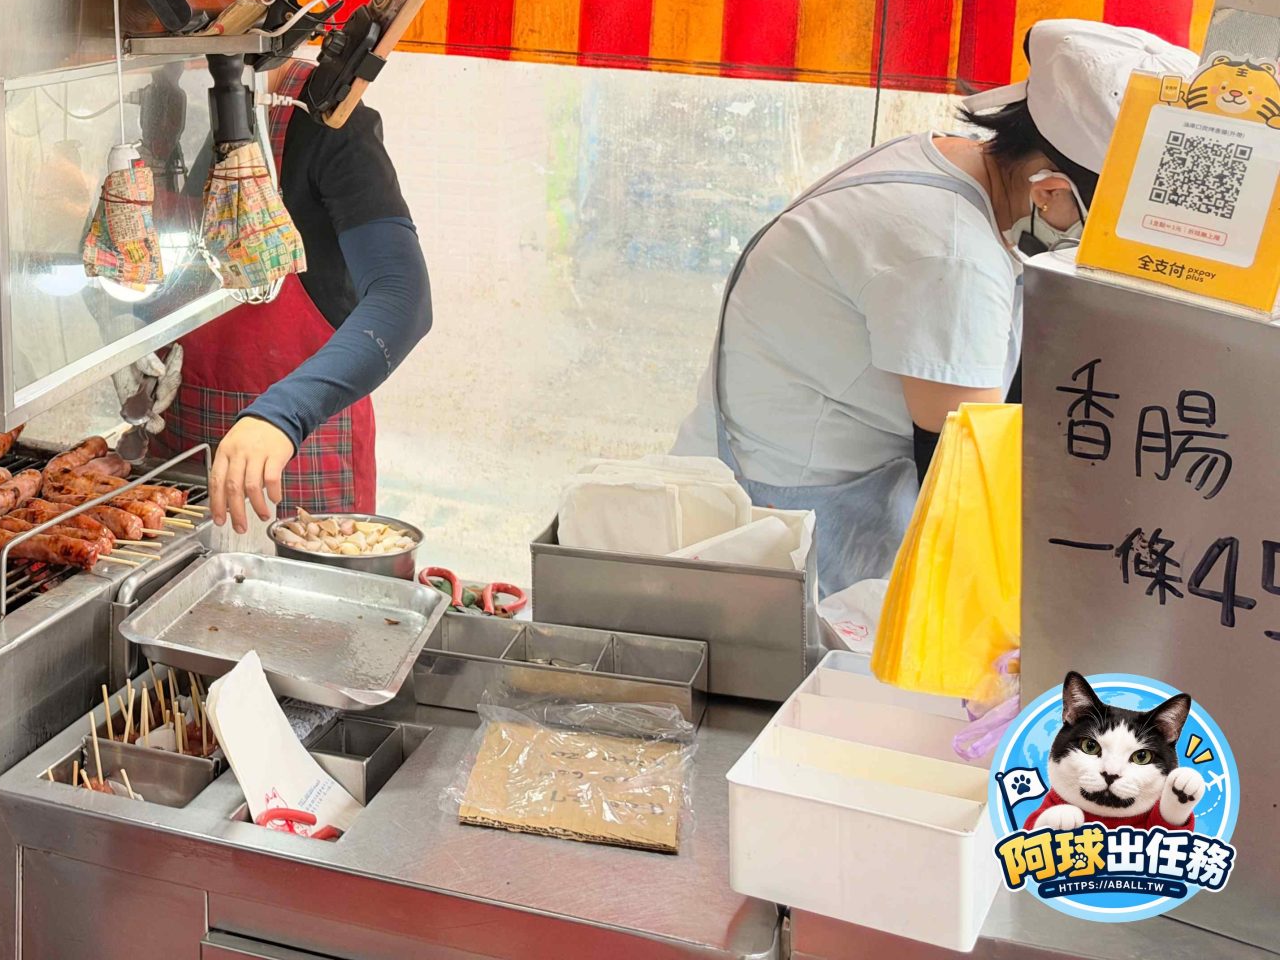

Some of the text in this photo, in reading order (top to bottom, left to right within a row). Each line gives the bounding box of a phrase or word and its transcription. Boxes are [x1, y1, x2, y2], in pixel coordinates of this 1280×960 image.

[1138, 255, 1185, 279] 全支付
[1187, 267, 1216, 279] pxpay
[1185, 274, 1204, 282] plus
[1055, 358, 1234, 501] 香腸
